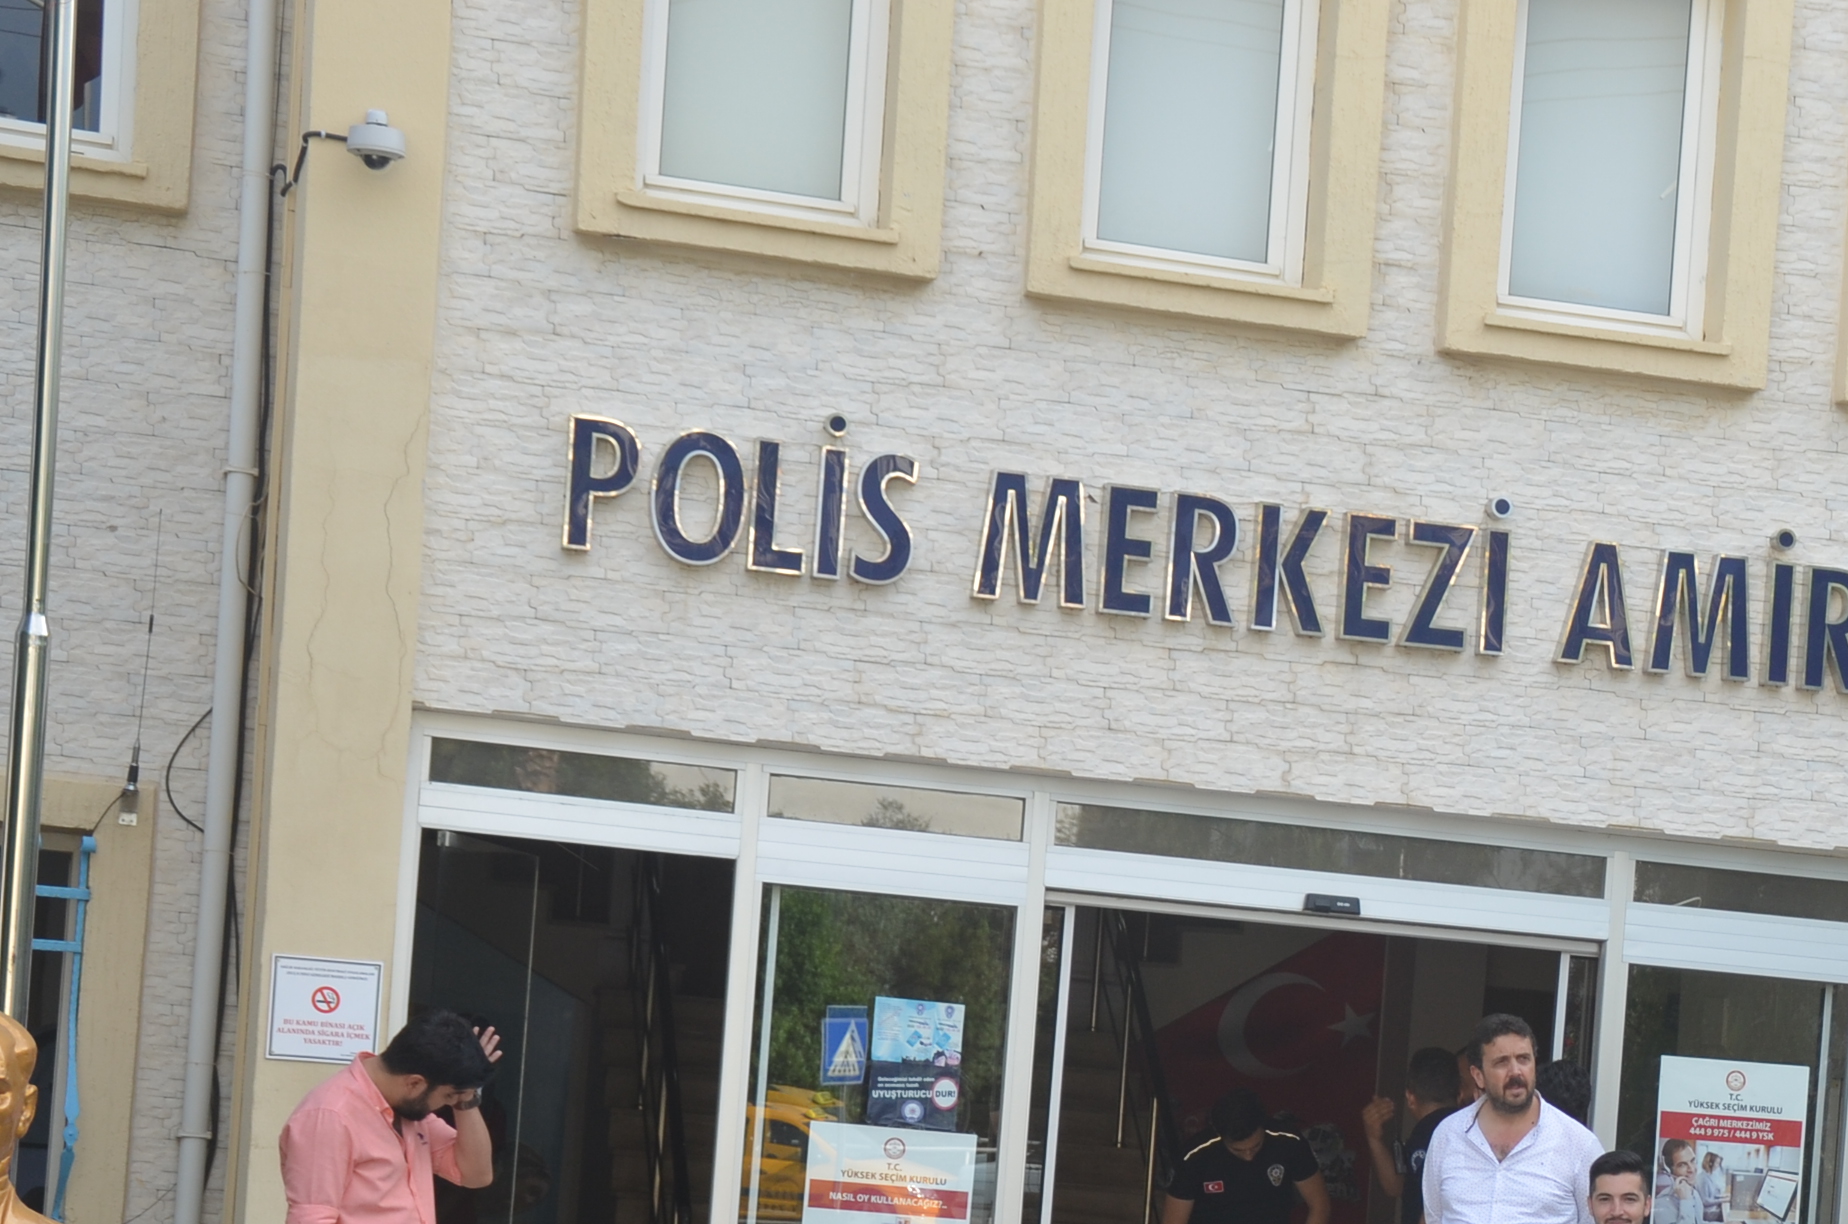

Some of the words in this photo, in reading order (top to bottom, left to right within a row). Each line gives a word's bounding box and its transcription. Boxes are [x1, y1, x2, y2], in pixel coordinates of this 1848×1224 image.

[559, 412, 919, 585] POLİS
[971, 469, 1513, 657] MERKEZİ
[295, 1019, 319, 1027] KAMU
[320, 1021, 346, 1029] BİNASI
[347, 1023, 366, 1031] AÇIK
[276, 1027, 315, 1036] ALANINDA
[317, 1029, 345, 1038] SİGARA
[346, 1032, 371, 1041] İÇMEK
[303, 1037, 343, 1047] YASAKTIR!
[872, 1089, 933, 1100] UYUŞTURUCU
[935, 1090, 956, 1098] DUR!
[1729, 1093, 1744, 1102] T.C.
[1688, 1099, 1721, 1110] YÜKSEK
[1722, 1102, 1748, 1113] SEÇİM
[1749, 1104, 1783, 1115] KURULU
[1691, 1116, 1718, 1127] ÇAĞRI
[1719, 1118, 1772, 1131] MERKEZİMİZ
[1689, 1126, 1705, 1135] 444
[1706, 1128, 1712, 1136] 9
[1713, 1129, 1729, 1138] 975
[1734, 1130, 1751, 1139] 444
[1751, 1131, 1757, 1140] 9
[1758, 1131, 1775, 1140] YSK
[886, 1162, 903, 1172] T.C.
[840, 1168, 877, 1180] YÜKSEK
[879, 1171, 908, 1183] SEÇİM
[909, 1174, 948, 1186] KURULU
[829, 1191, 856, 1202] NASIL
[857, 1193, 870, 1202] OY
